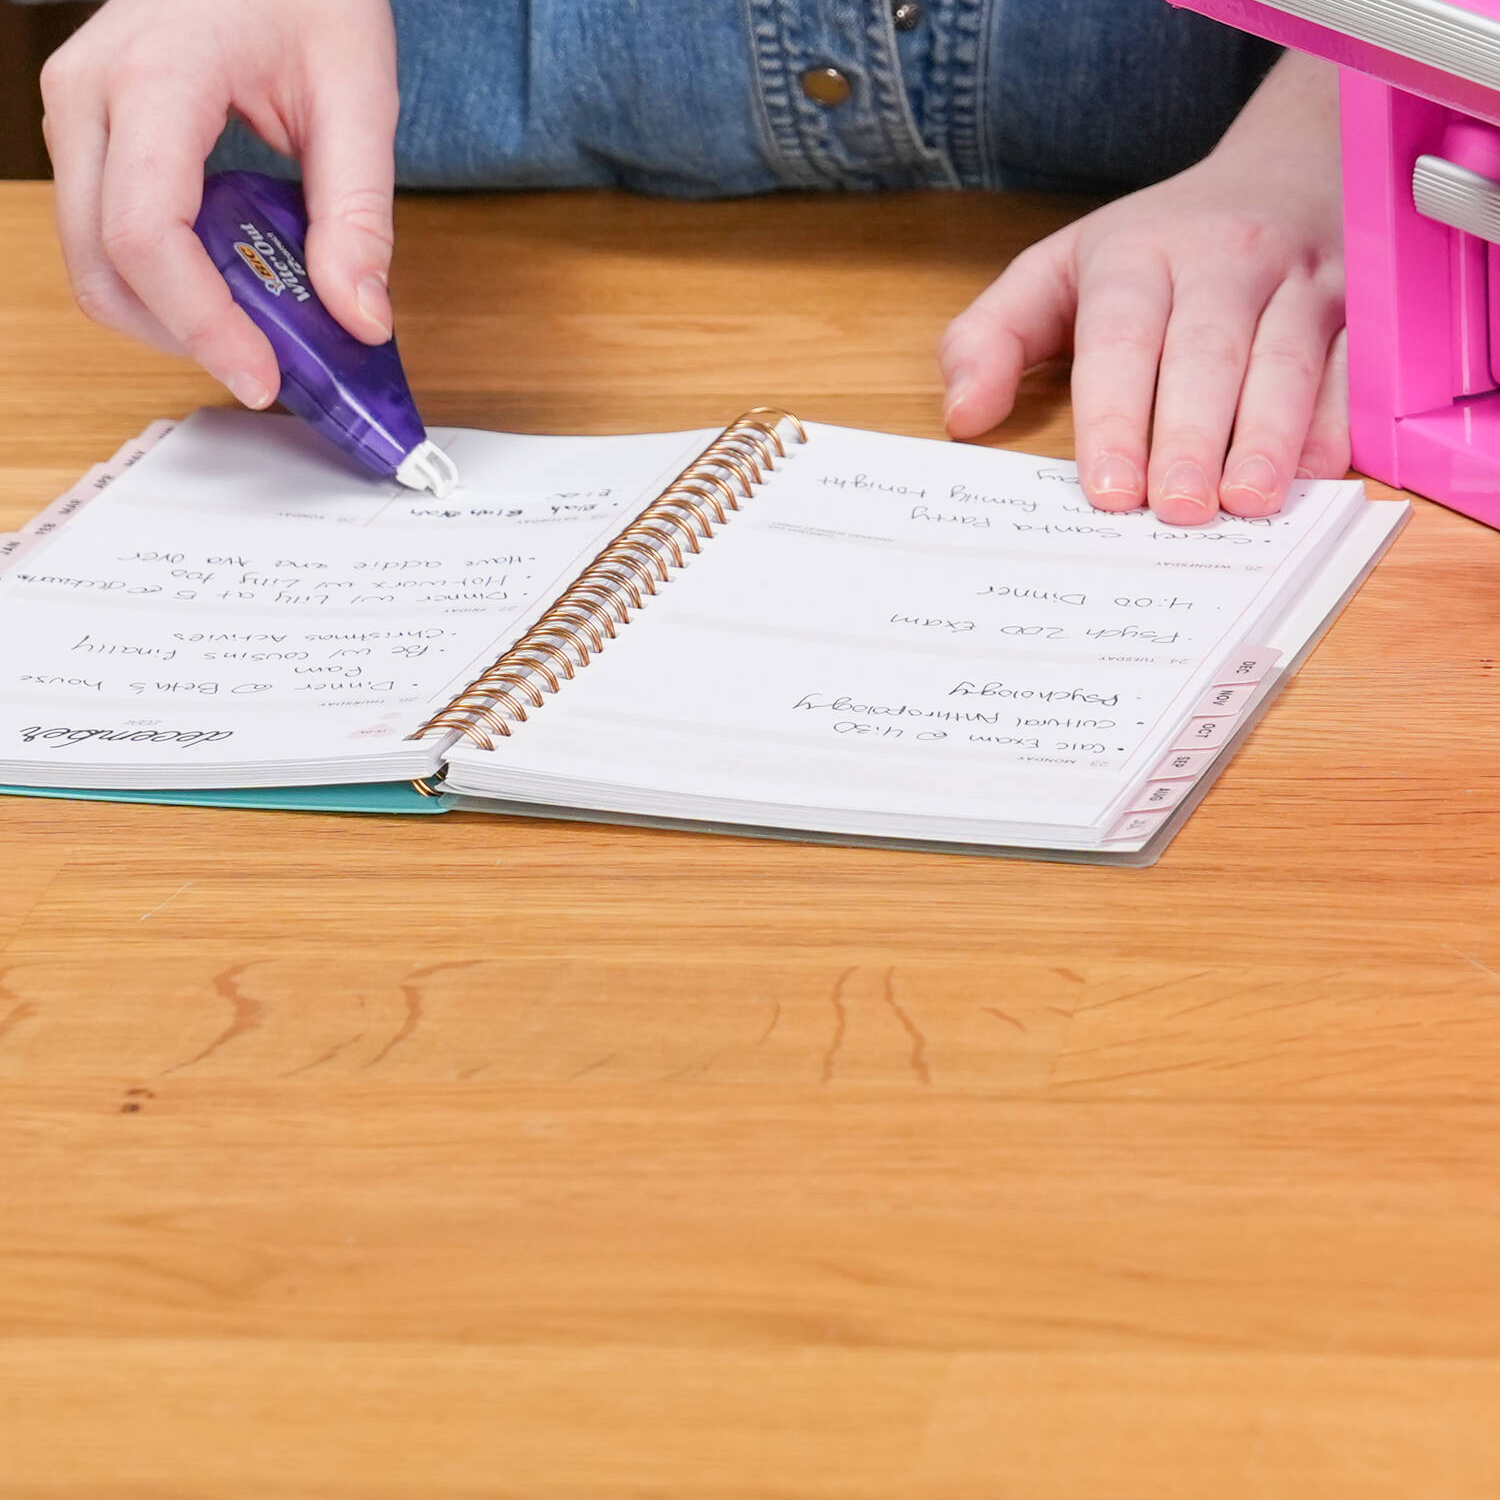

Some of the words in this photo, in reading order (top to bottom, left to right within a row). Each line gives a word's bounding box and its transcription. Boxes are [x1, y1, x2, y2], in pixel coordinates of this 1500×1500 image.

[239, 246, 272, 276] BIC
[240, 223, 310, 302] Wite-Out
[816, 474, 926, 498] tonight
[949, 485, 1039, 513] family
[911, 506, 990, 528] Party
[1012, 522, 1122, 539] Santa
[1147, 532, 1252, 544] Secret
[465, 556, 522, 568] Have
[1153, 561, 1231, 570] WEDNESDAY
[170, 569, 215, 584] too
[217, 590, 255, 602] at
[416, 591, 507, 603] Dinner
[975, 585, 1087, 606] Dinner
[1113, 597, 1193, 610] 4:00
[890, 613, 976, 634] Exam
[305, 628, 444, 644] Christmas
[1000, 626, 1069, 640] 200
[1084, 625, 1181, 644] Psych
[203, 650, 309, 663] cousins
[1097, 656, 1154, 664] TUESDAY
[1236, 661, 1256, 674] DEC
[18, 675, 102, 692] house
[129, 681, 219, 696] Beth's
[294, 680, 394, 692] Dinner
[948, 682, 1119, 707] Psychology
[1213, 690, 1234, 706] NOV
[792, 694, 999, 725] Anthropology
[17, 725, 234, 749] december
[832, 721, 904, 739] 4:30
[915, 730, 948, 741] @
[1195, 723, 1215, 738] OCT
[969, 733, 1040, 749] Exam
[1055, 741, 1106, 754] Calc
[1015, 756, 1077, 764] MONDAY
[1172, 756, 1191, 768] SEP
